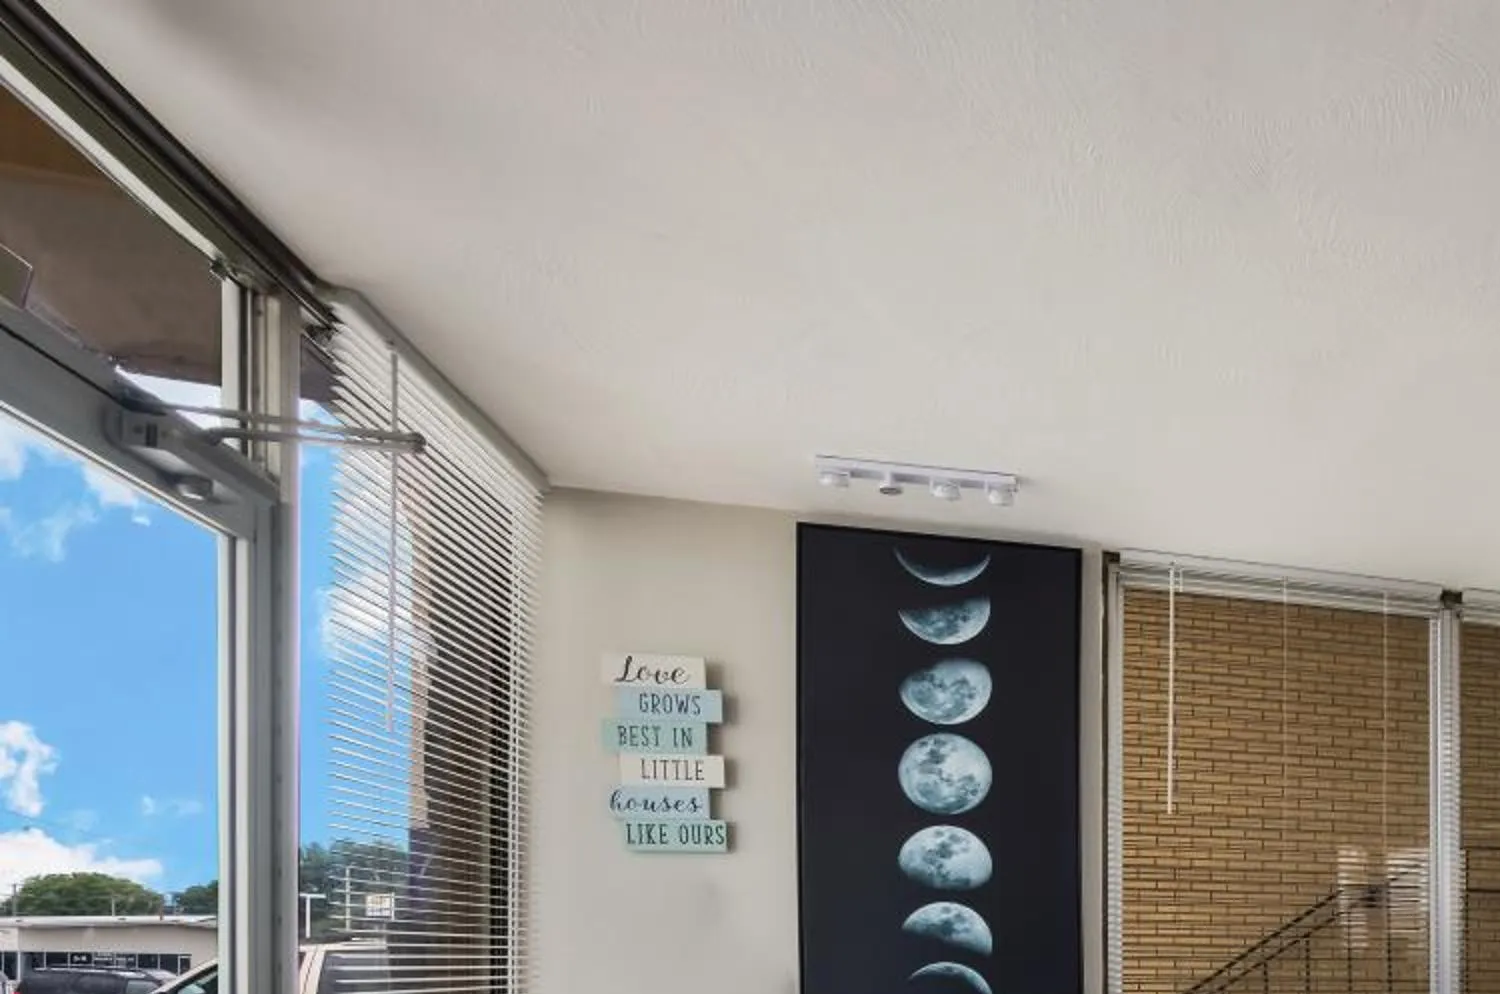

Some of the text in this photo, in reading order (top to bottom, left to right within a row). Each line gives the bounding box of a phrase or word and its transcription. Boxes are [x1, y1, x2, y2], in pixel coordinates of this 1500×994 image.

[614, 655, 690, 684] Love
[638, 692, 701, 715] GROWS
[617, 725, 693, 748] BEST IN
[640, 758, 705, 781] LITTLE
[609, 788, 703, 813] houses
[626, 822, 725, 845] LIKE OURS
